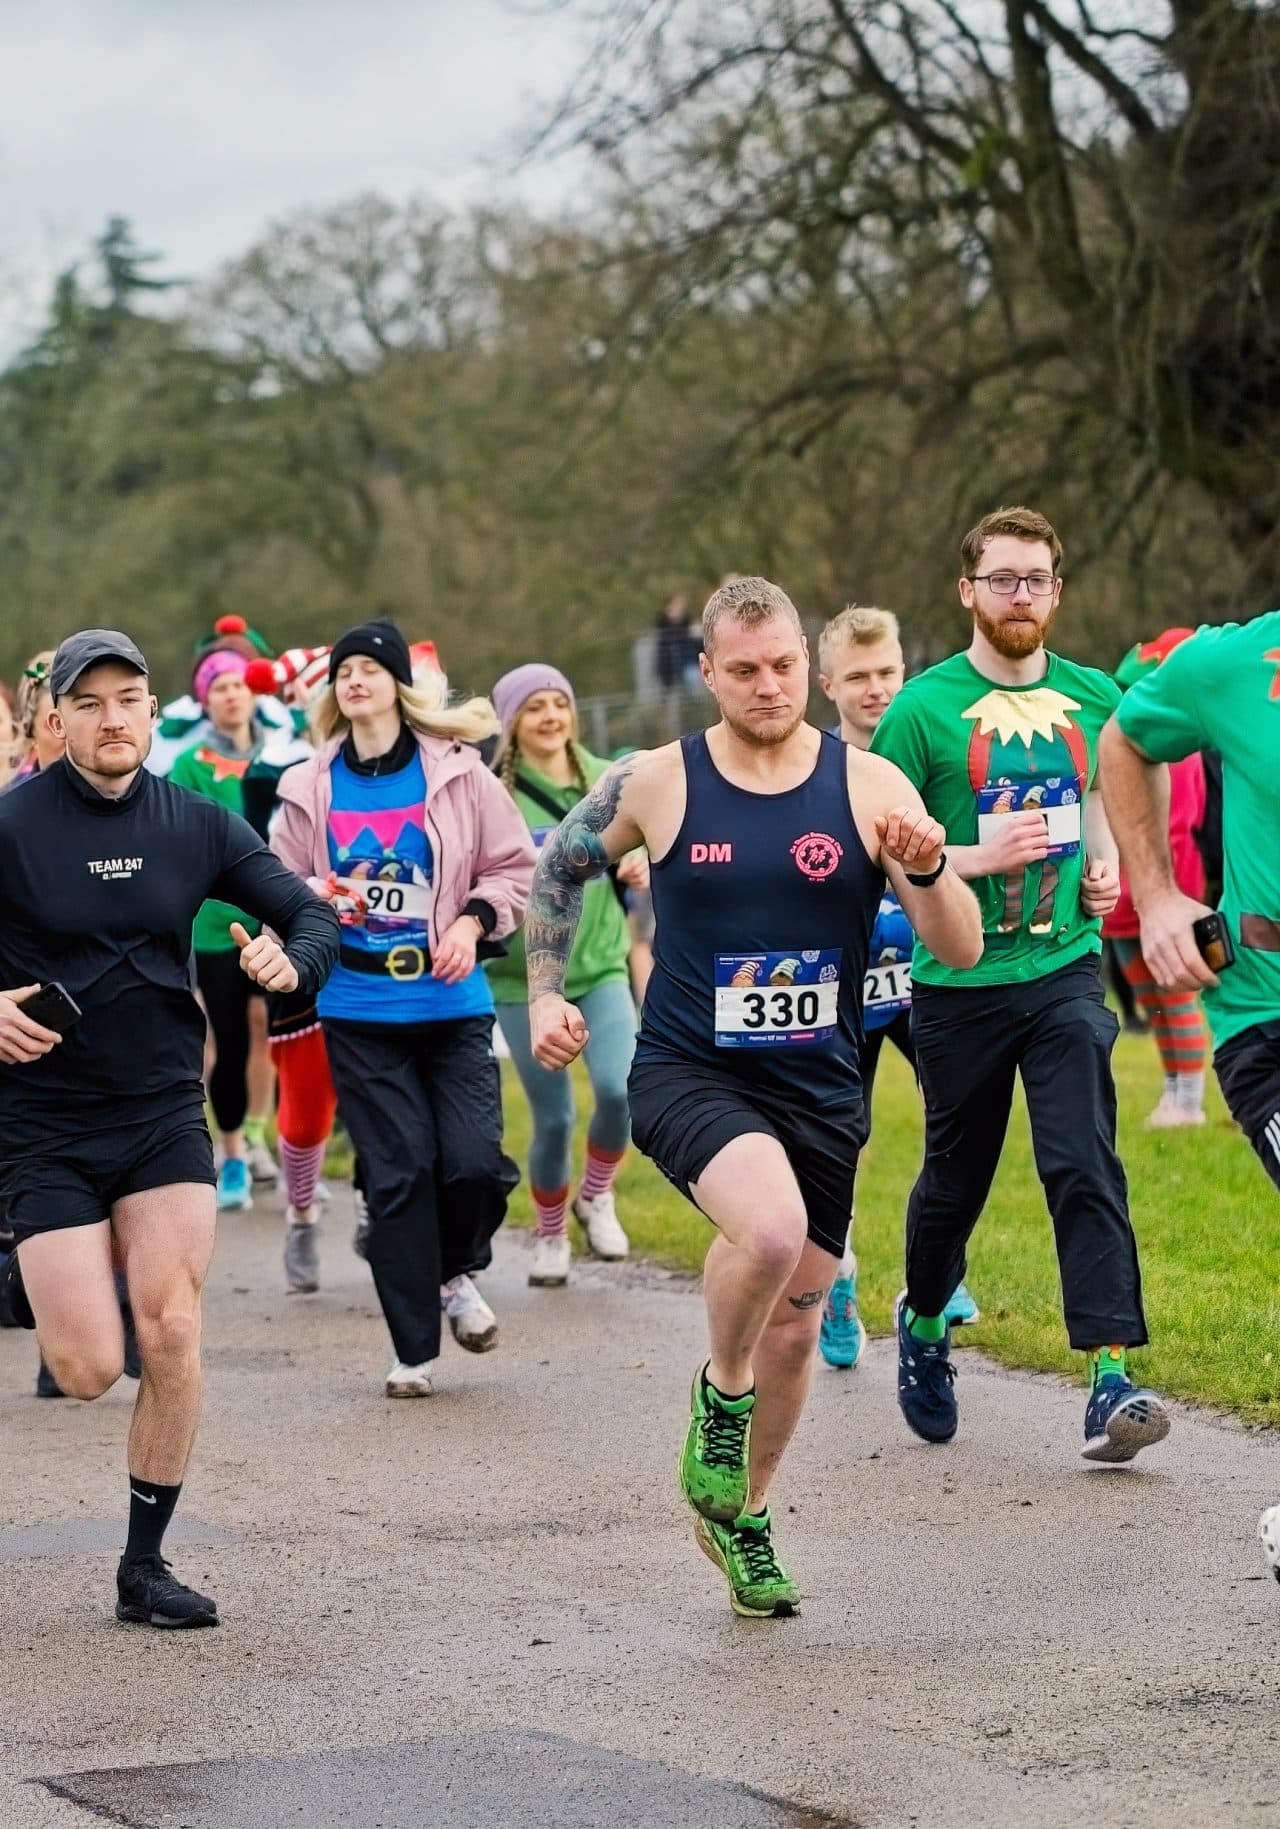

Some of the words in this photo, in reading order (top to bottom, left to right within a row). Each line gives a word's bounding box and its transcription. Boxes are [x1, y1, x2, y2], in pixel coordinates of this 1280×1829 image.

[87, 859, 123, 874] TEAM
[124, 857, 144, 871] 247
[691, 843, 732, 864] DM
[367, 886, 404, 913] 90
[742, 991, 819, 1029] 330
